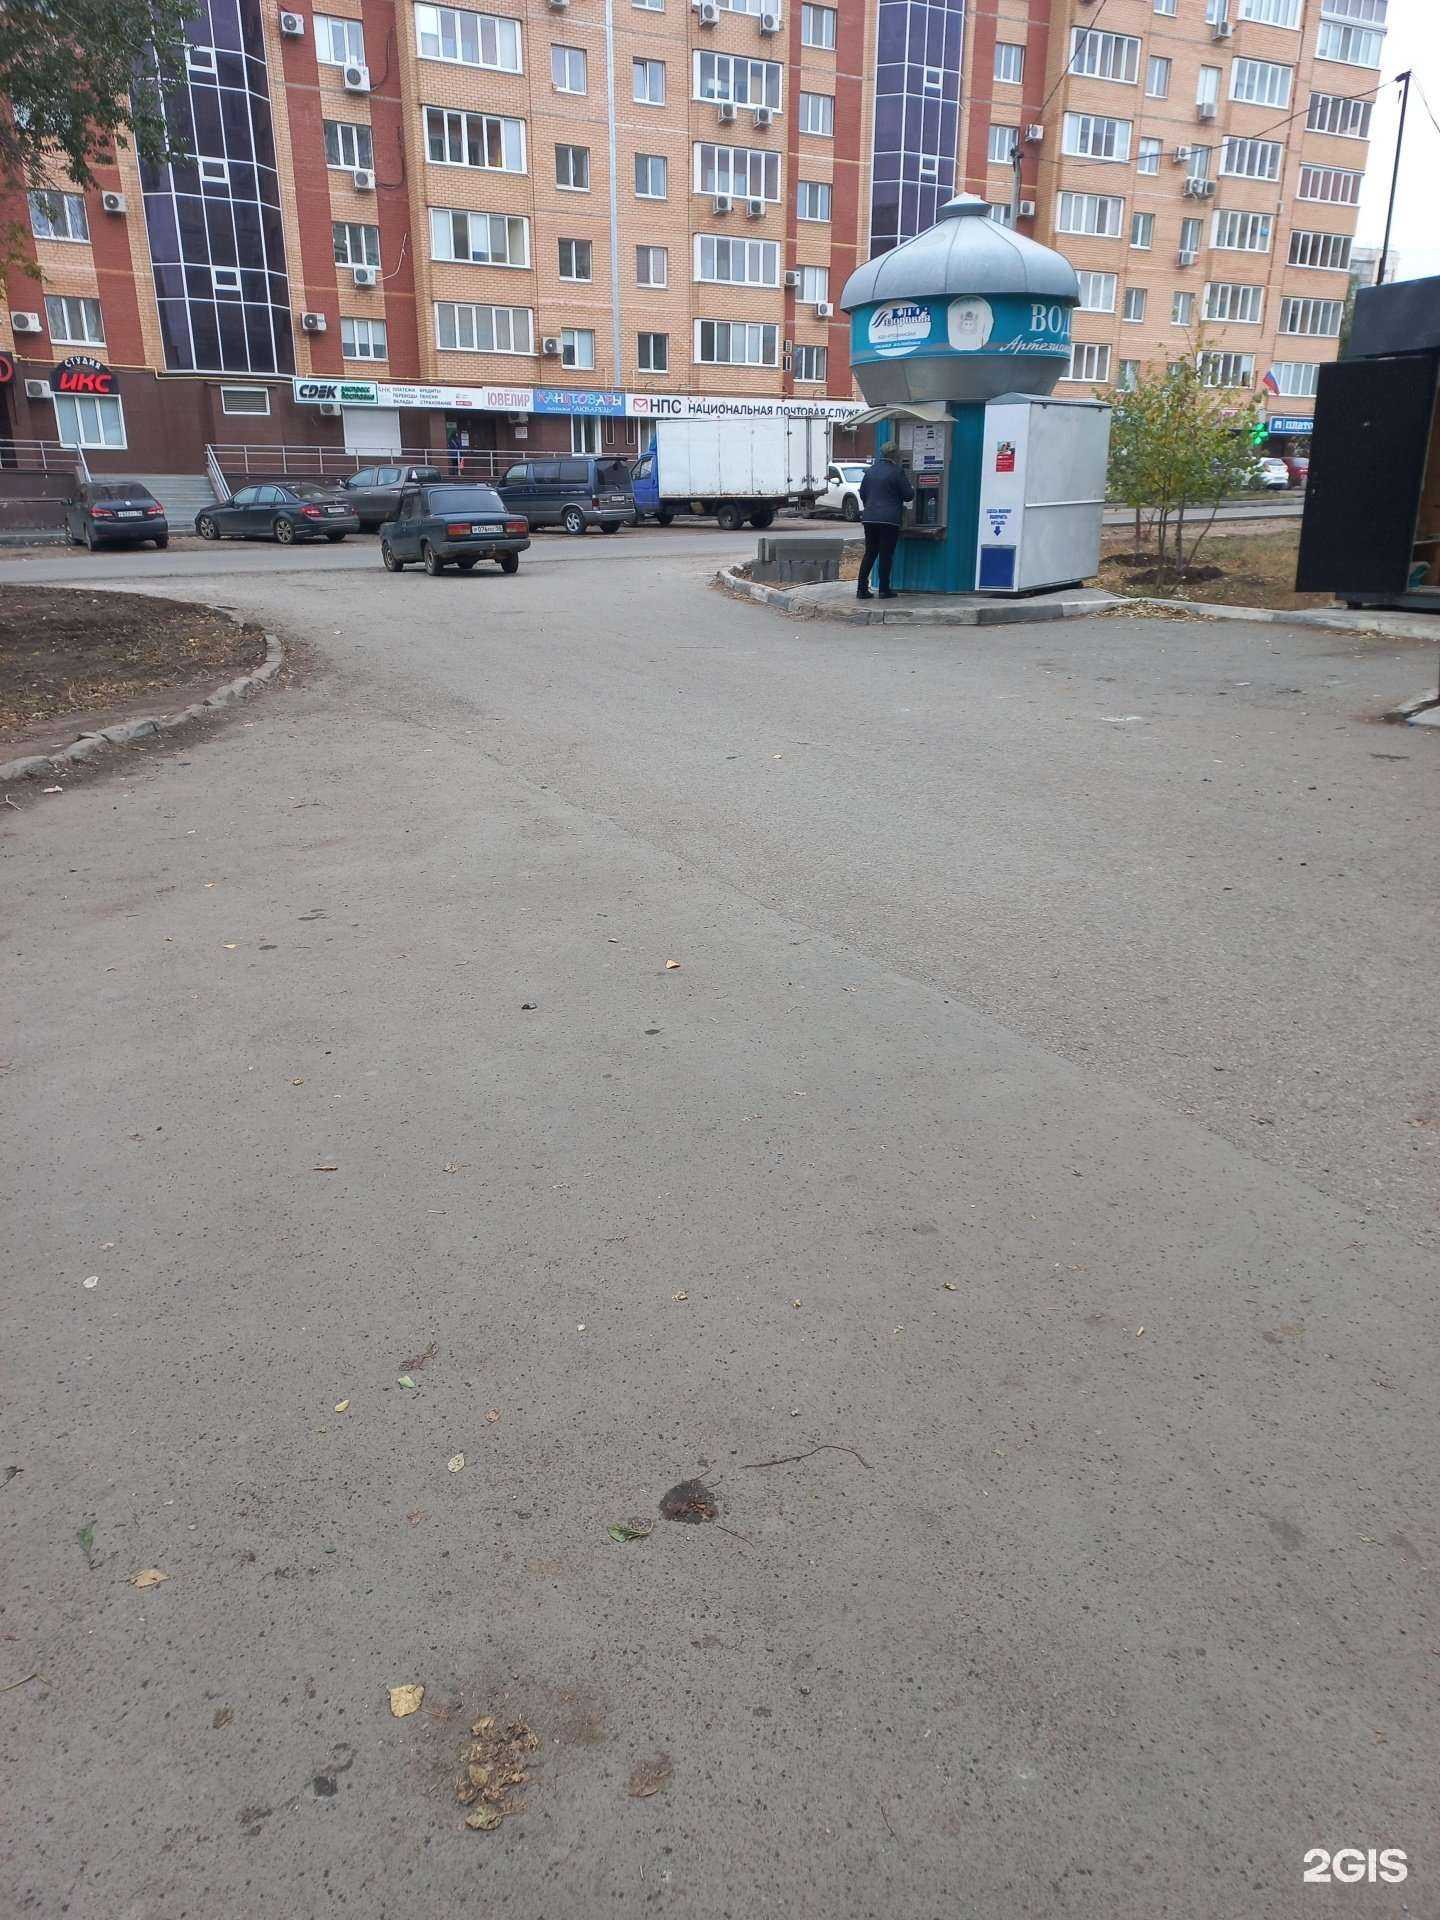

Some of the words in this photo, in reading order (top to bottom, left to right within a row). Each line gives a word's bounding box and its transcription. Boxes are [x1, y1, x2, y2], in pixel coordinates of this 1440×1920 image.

[64, 356, 101, 370] СТУДИЯ
[60, 372, 112, 393] ИКС
[299, 384, 338, 399] CDEK
[487, 391, 530, 407] ЮВЕЛИР
[650, 399, 682, 414] НПС
[687, 403, 773, 415] НАЦИОНАЛЬНАЯ
